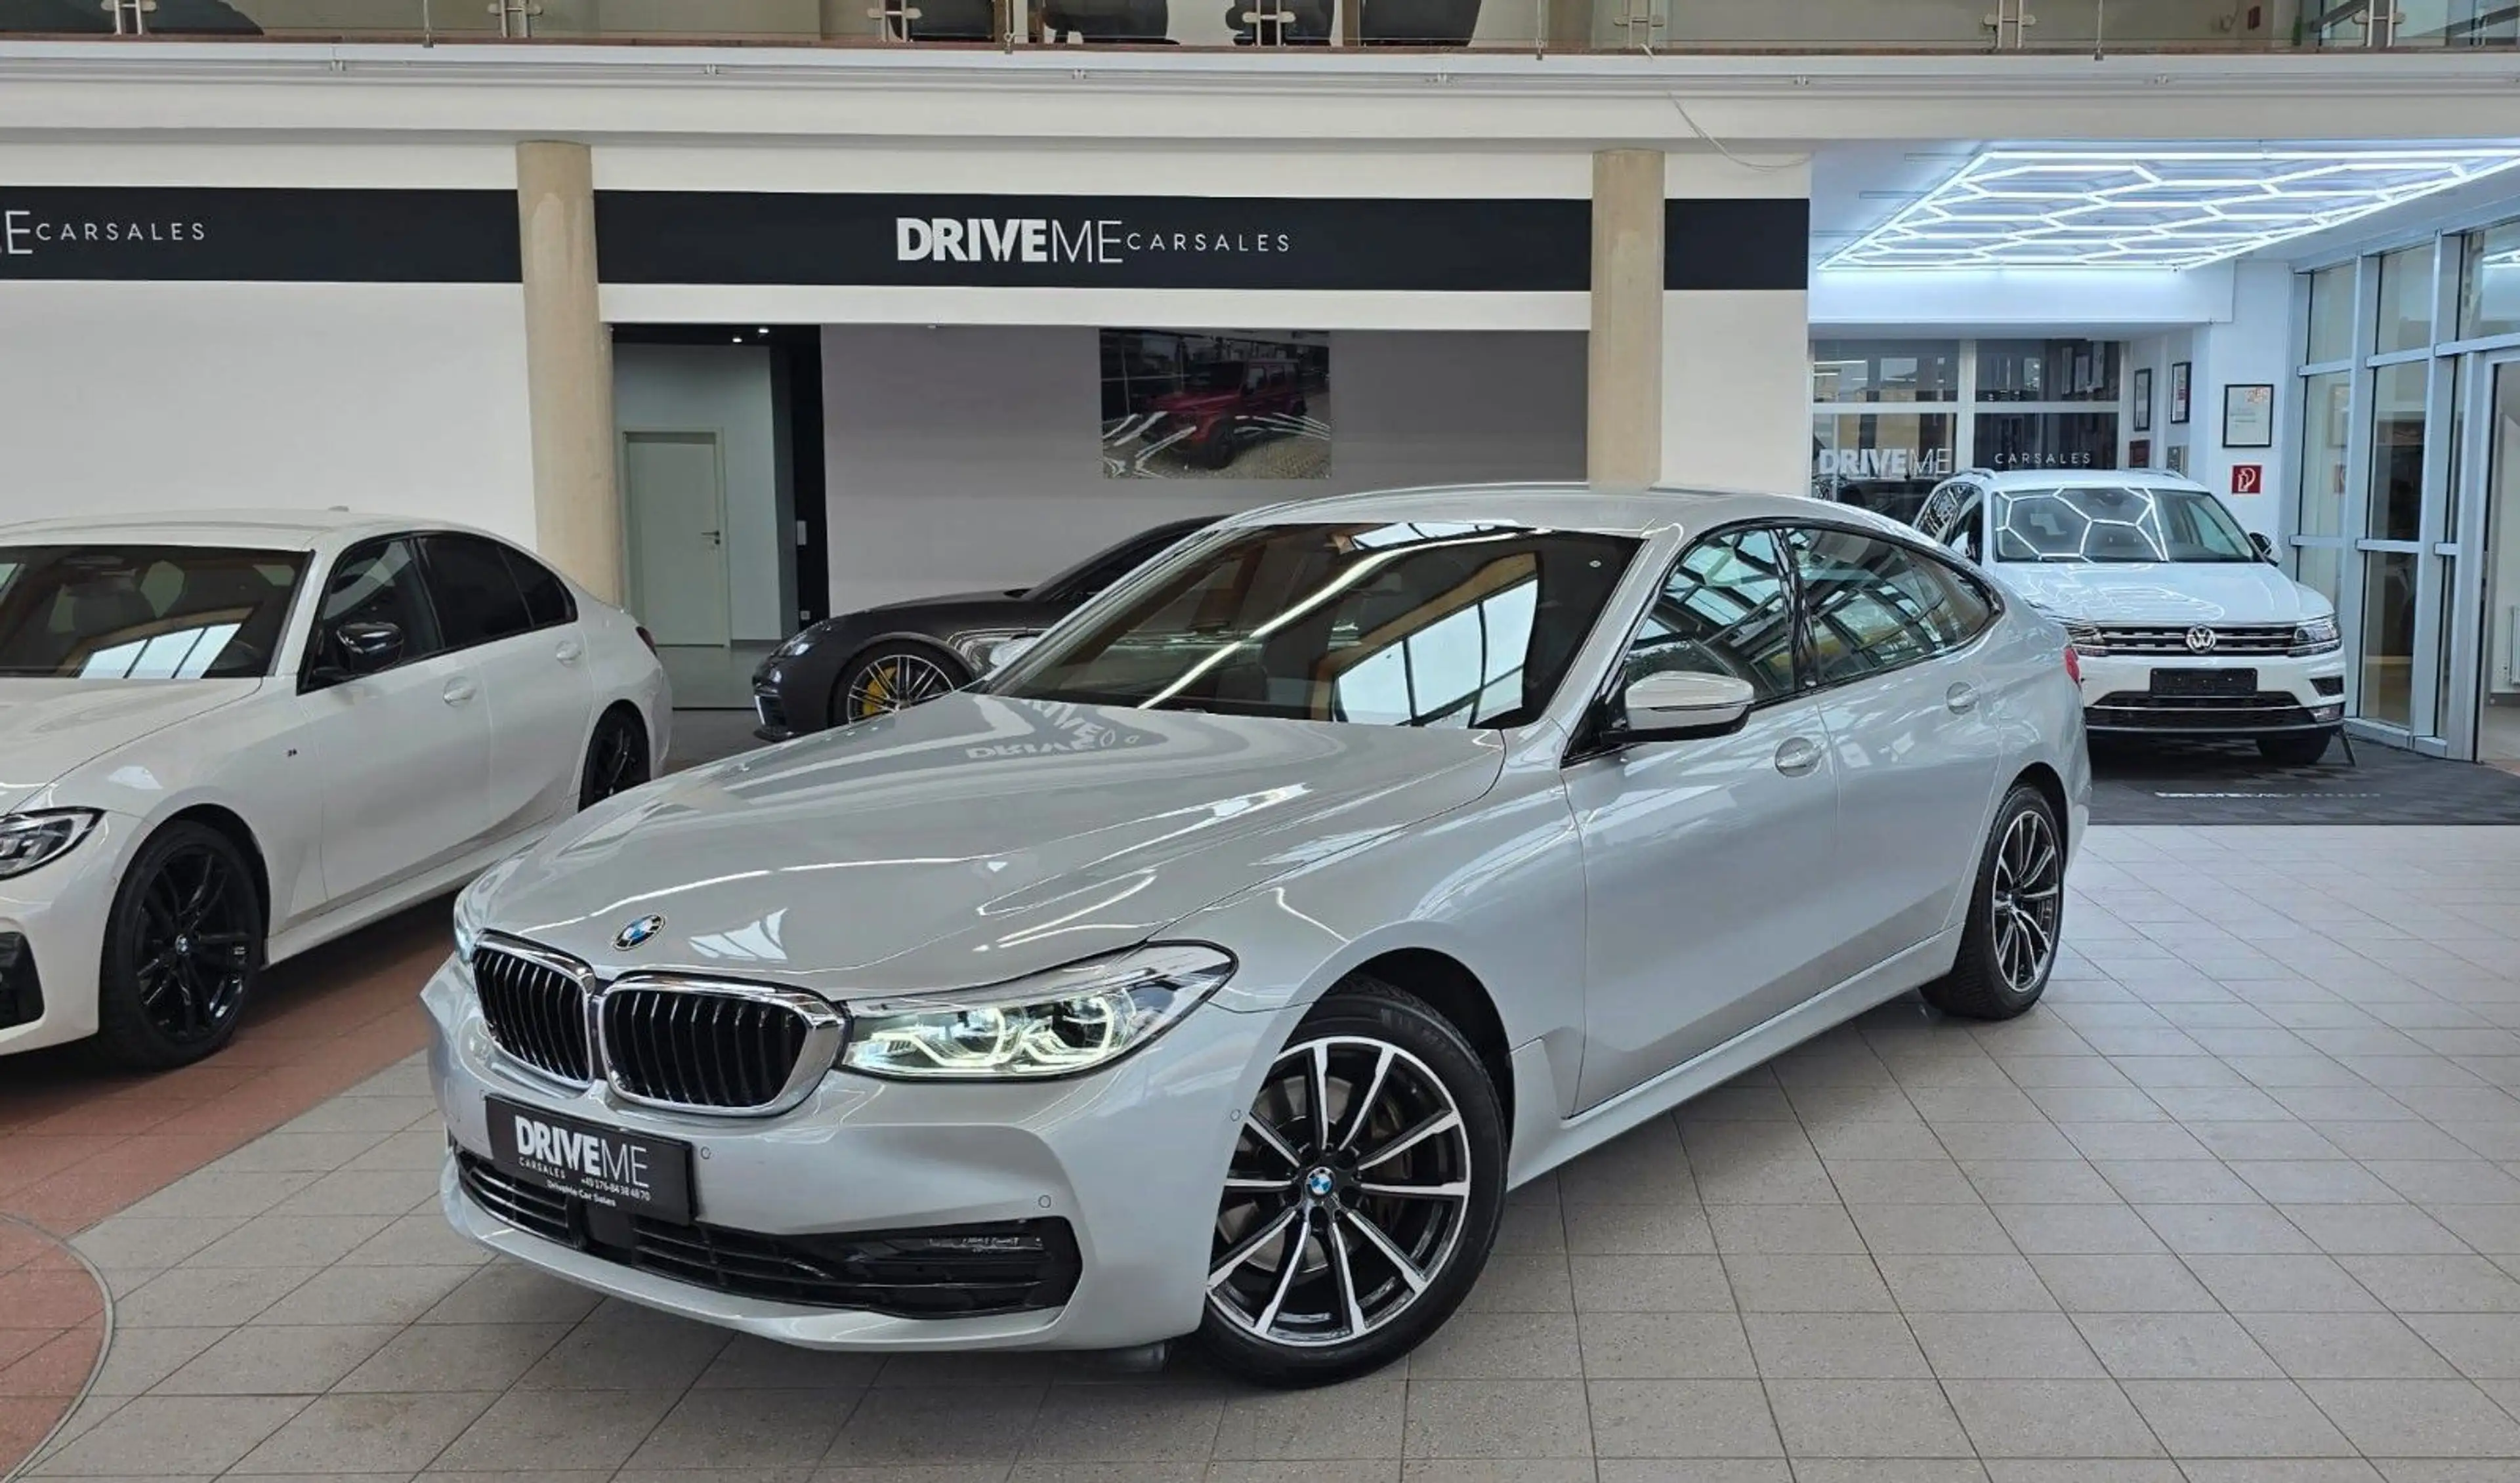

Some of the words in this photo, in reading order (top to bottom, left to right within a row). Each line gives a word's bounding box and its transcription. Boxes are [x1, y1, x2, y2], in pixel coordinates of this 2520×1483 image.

[35, 222, 205, 241] CARSALES
[895, 217, 1124, 263] DRIVEME
[1126, 232, 1291, 253] CARSALES
[1818, 448, 1954, 474] DRIVEME
[1994, 452, 2091, 465] CARSALES
[514, 1115, 650, 1188] DRIVEME
[518, 1156, 566, 1179] CARSALES
